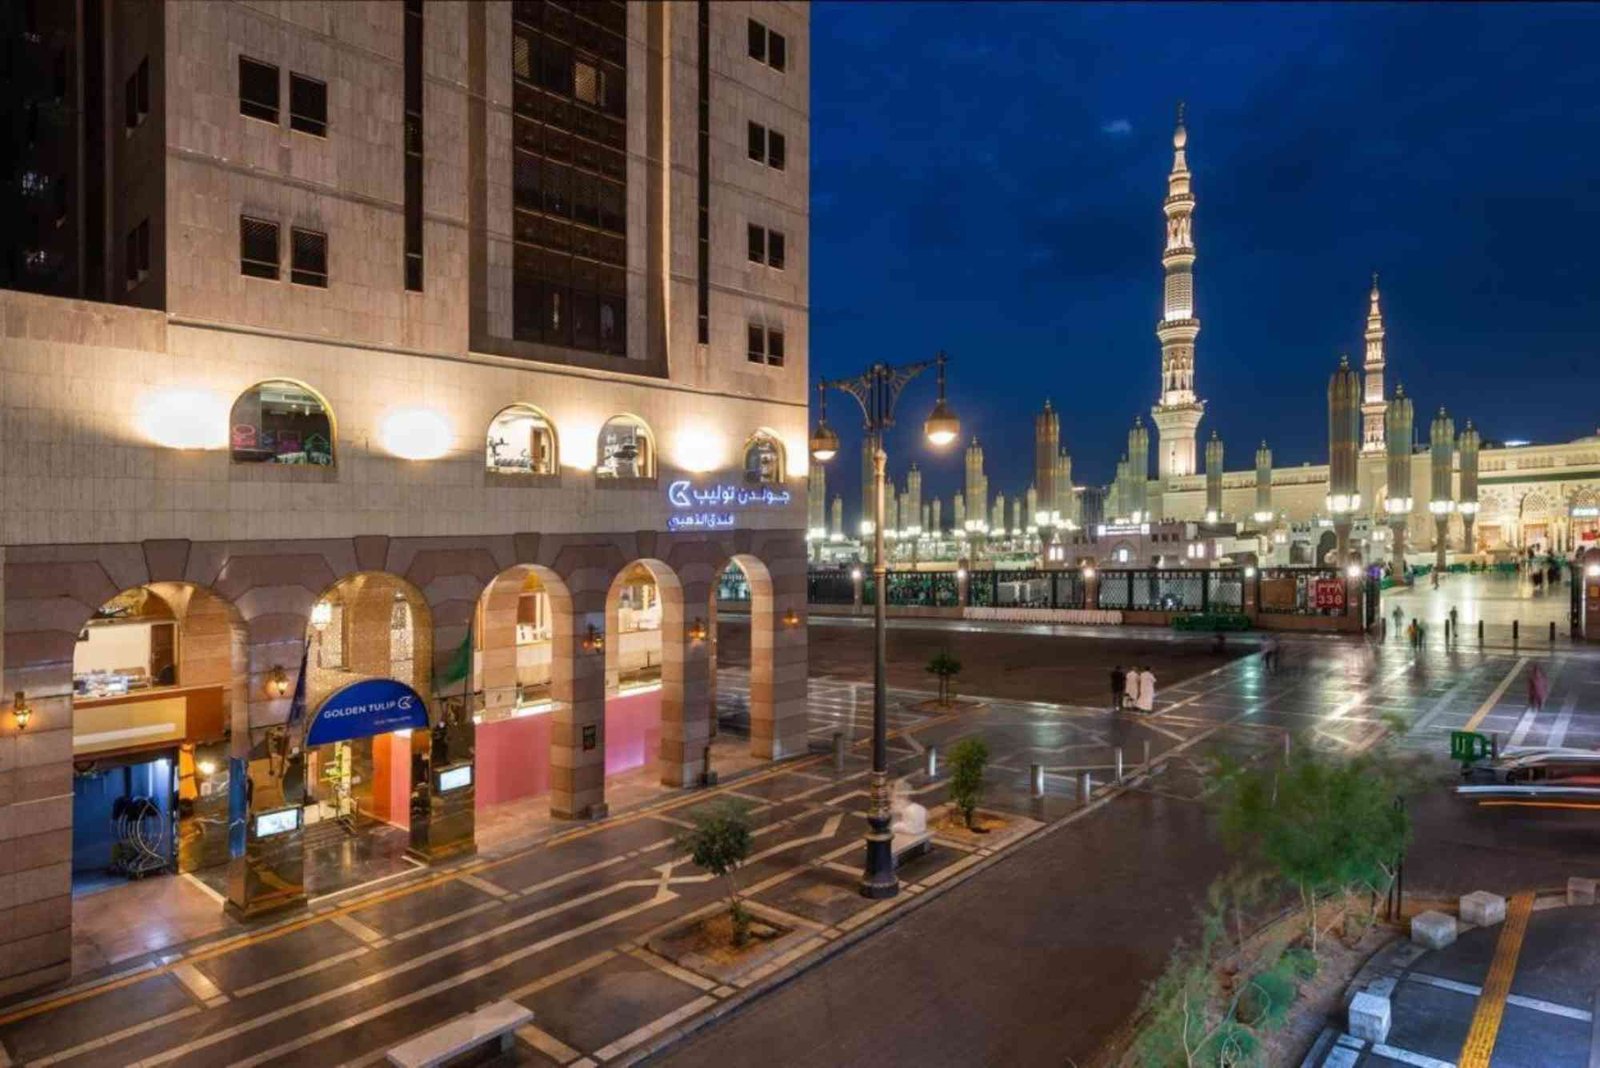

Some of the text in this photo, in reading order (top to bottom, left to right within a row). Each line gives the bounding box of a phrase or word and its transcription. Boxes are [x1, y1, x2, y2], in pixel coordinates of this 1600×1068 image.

[693, 484, 735, 505] توليب
[1318, 594, 1343, 605] 338
[323, 700, 396, 719] GOLDEN TULIP
